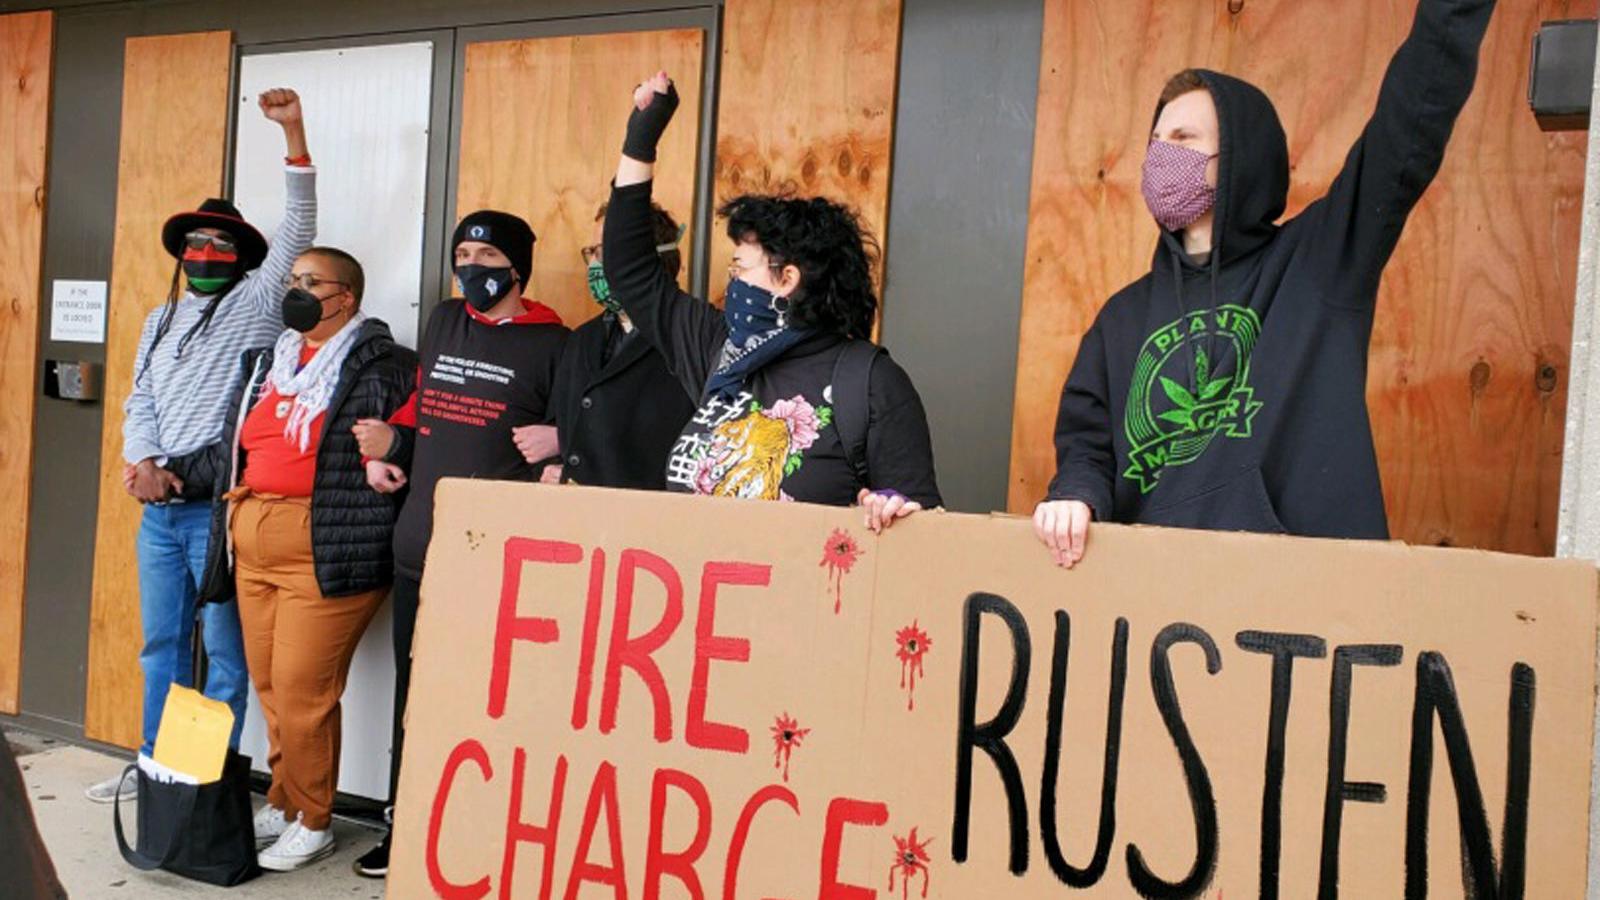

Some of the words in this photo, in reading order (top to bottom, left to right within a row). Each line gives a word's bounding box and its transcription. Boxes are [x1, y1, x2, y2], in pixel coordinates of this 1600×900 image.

[1153, 310, 1242, 353] PLANT
[486, 536, 772, 754] FIRE
[425, 739, 889, 900] CHARGE
[951, 591, 1537, 900] RUSTEN
